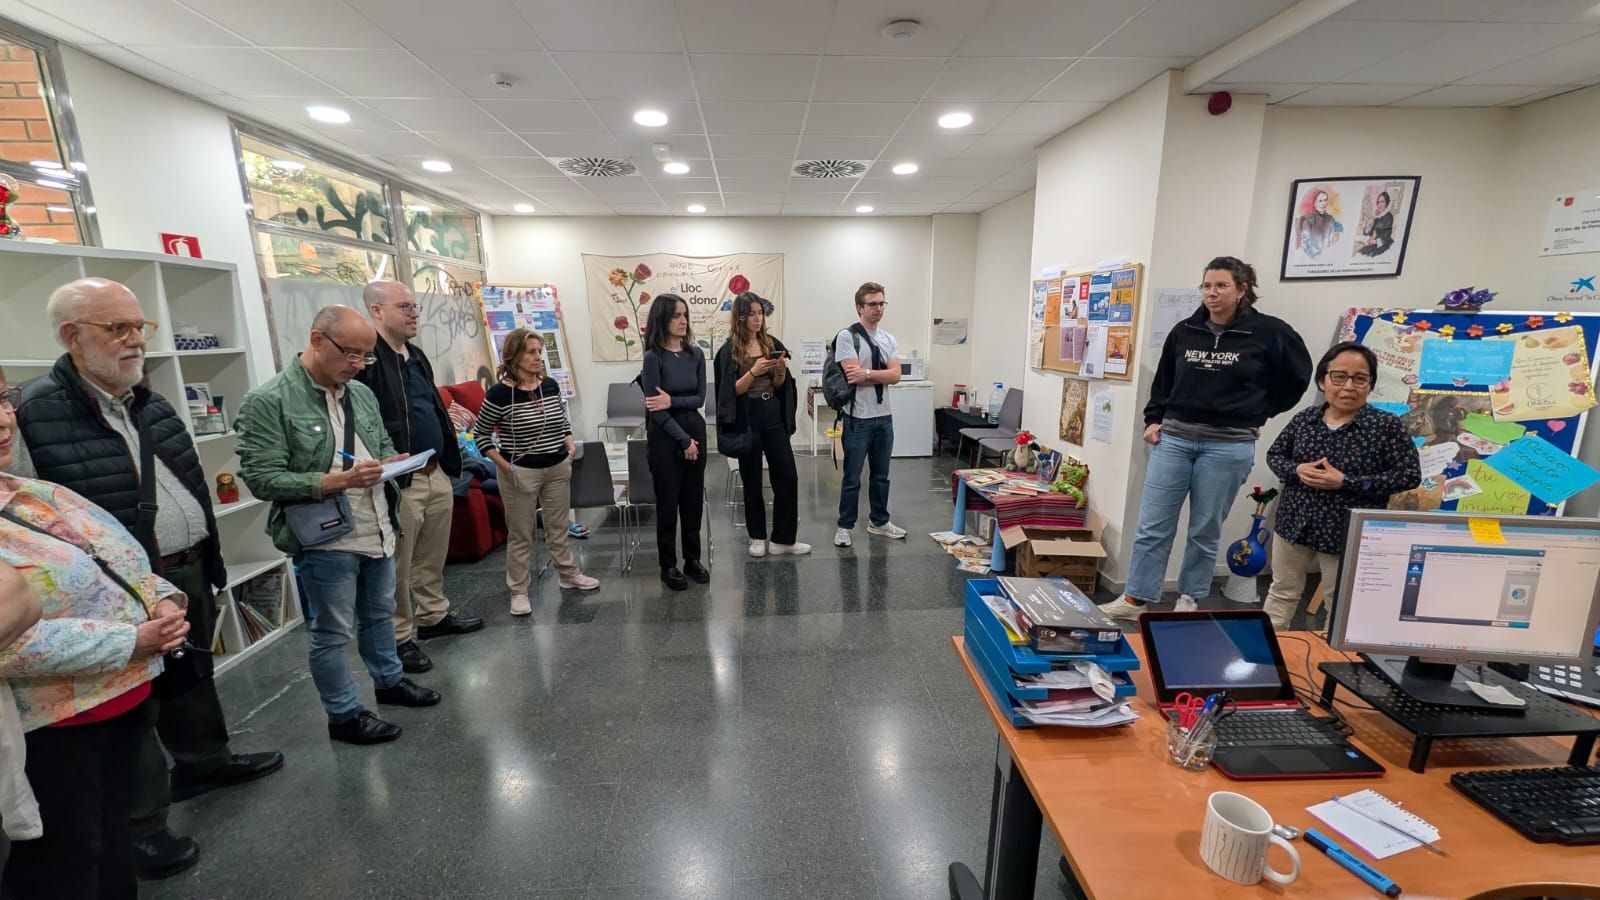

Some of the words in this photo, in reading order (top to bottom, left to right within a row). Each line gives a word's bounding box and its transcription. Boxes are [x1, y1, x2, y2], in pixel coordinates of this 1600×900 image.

[680, 283, 702, 293] Lloc
[689, 295, 717, 305] dona
[1184, 349, 1208, 359] NEW
[1211, 352, 1240, 361] YORK
